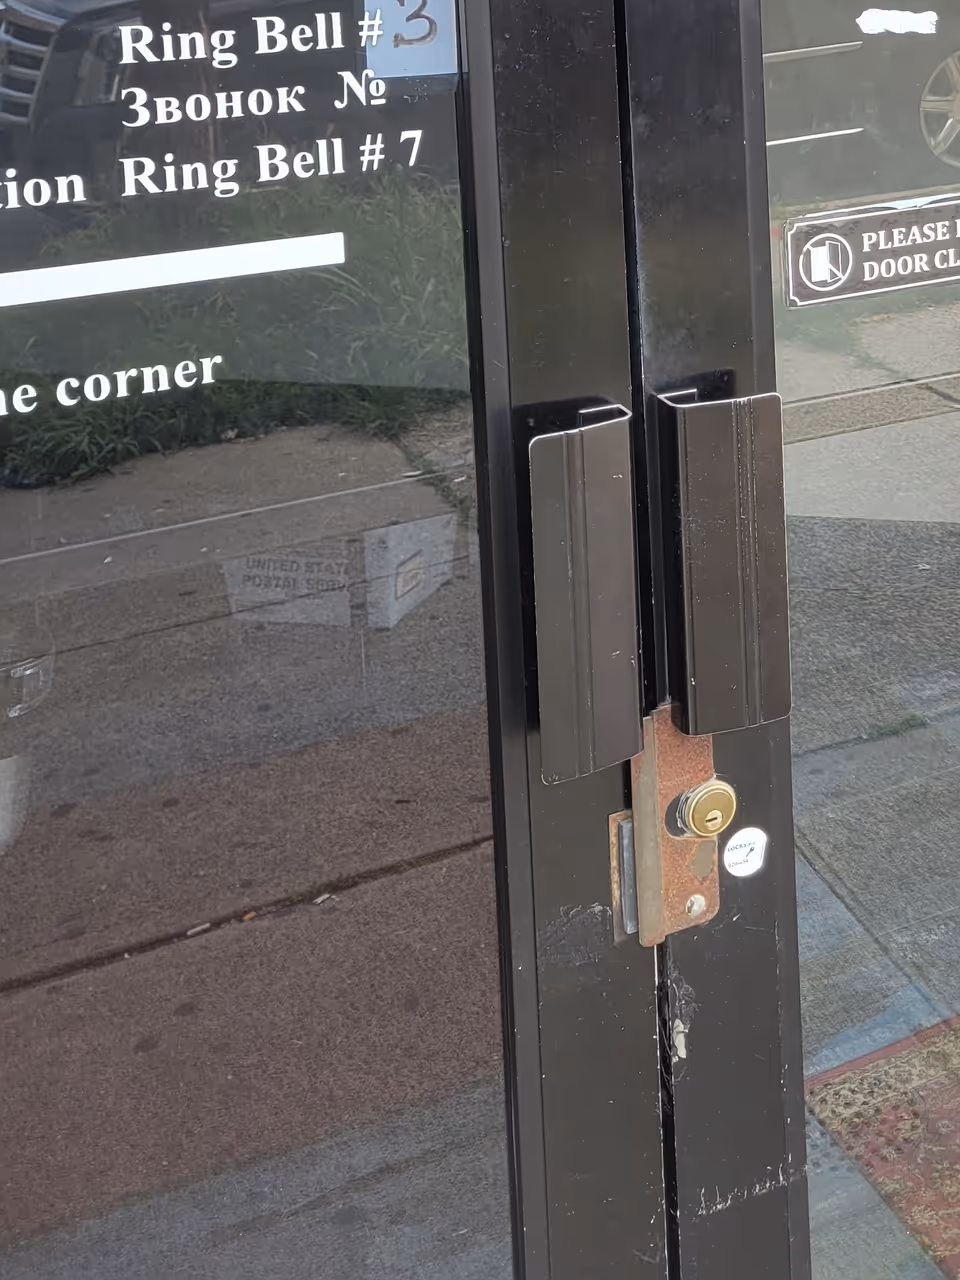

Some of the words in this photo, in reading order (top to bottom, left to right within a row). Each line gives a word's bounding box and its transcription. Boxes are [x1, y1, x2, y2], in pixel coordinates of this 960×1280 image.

[118, 23, 239, 70] Ring
[253, 11, 344, 57] Bell
[0, 168, 87, 210] ion
[119, 154, 241, 199] Ring
[256, 137, 346, 183] Bell
[861, 222, 950, 253] PLEASE
[863, 253, 931, 282] DOOR
[56, 354, 224, 406] corner
